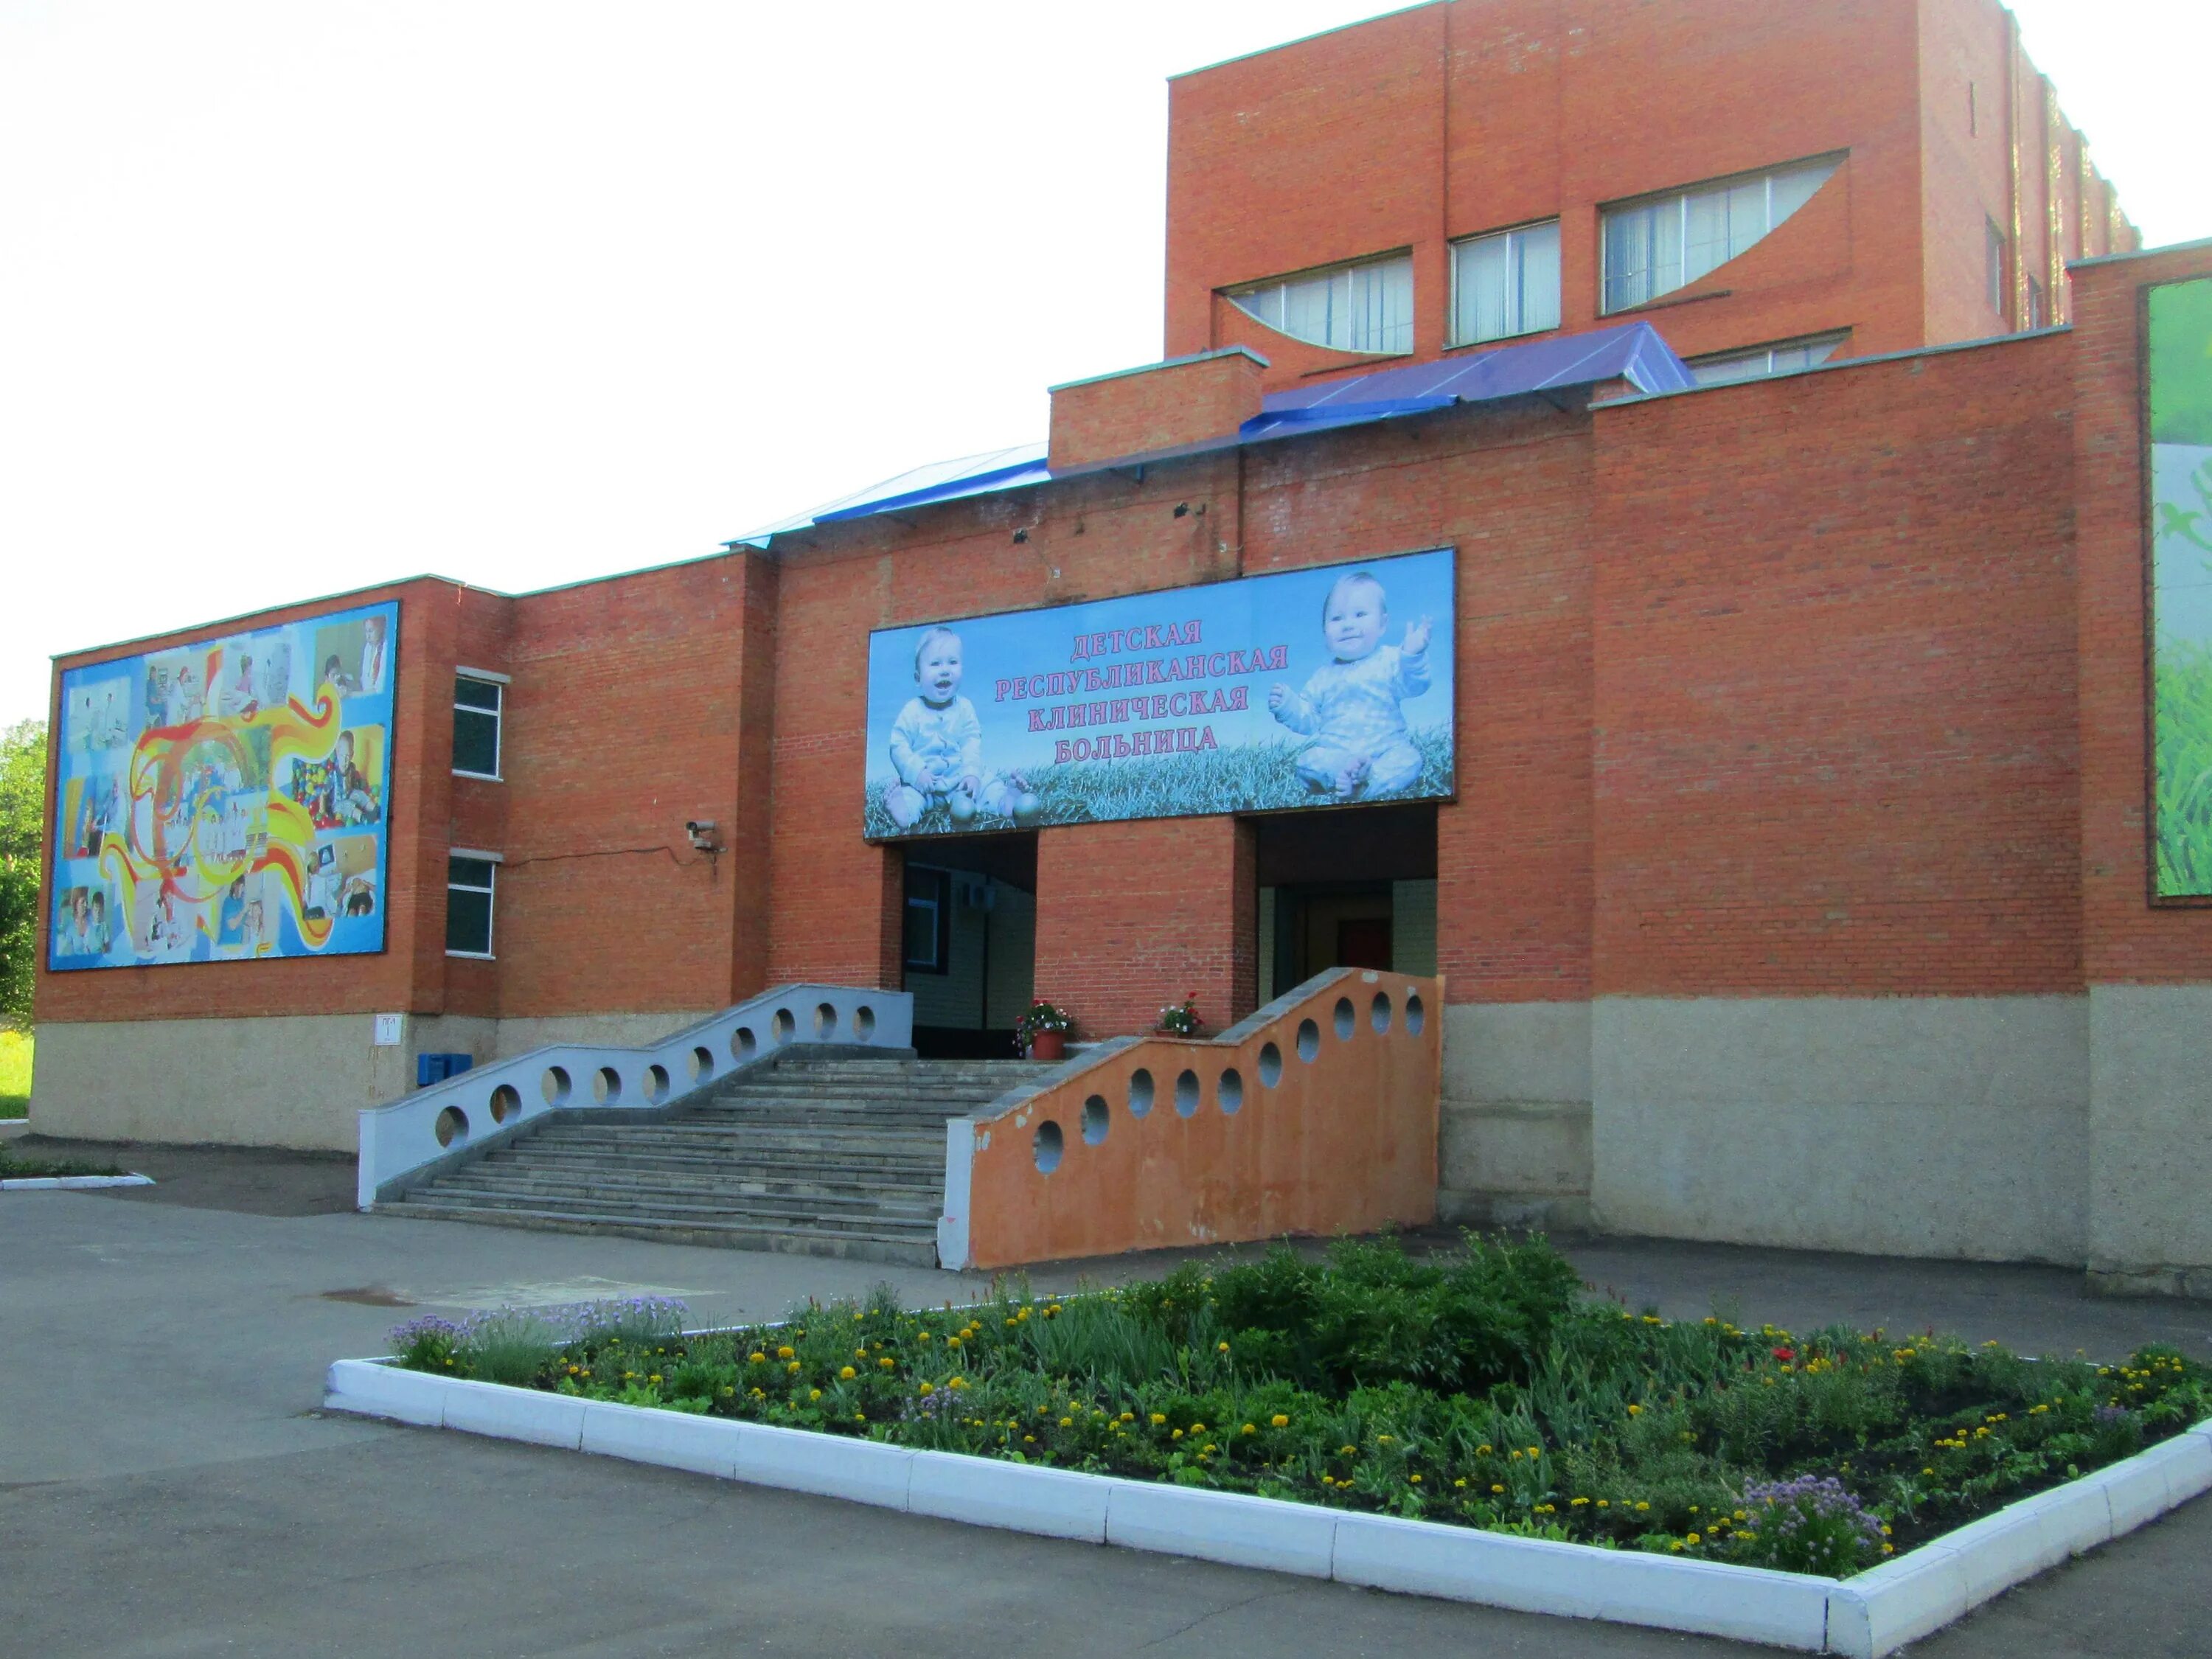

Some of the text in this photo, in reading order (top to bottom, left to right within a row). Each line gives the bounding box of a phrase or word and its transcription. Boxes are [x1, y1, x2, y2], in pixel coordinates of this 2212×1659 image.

[1070, 619, 1203, 662] ДЕТСКАЯ
[995, 645, 1289, 702] РЕСПУБЛИКАНСКАЯ
[1028, 686, 1249, 732] КЛИНИЧЕСКАЯ
[1054, 726, 1217, 764] БОЛЬНИЦА
